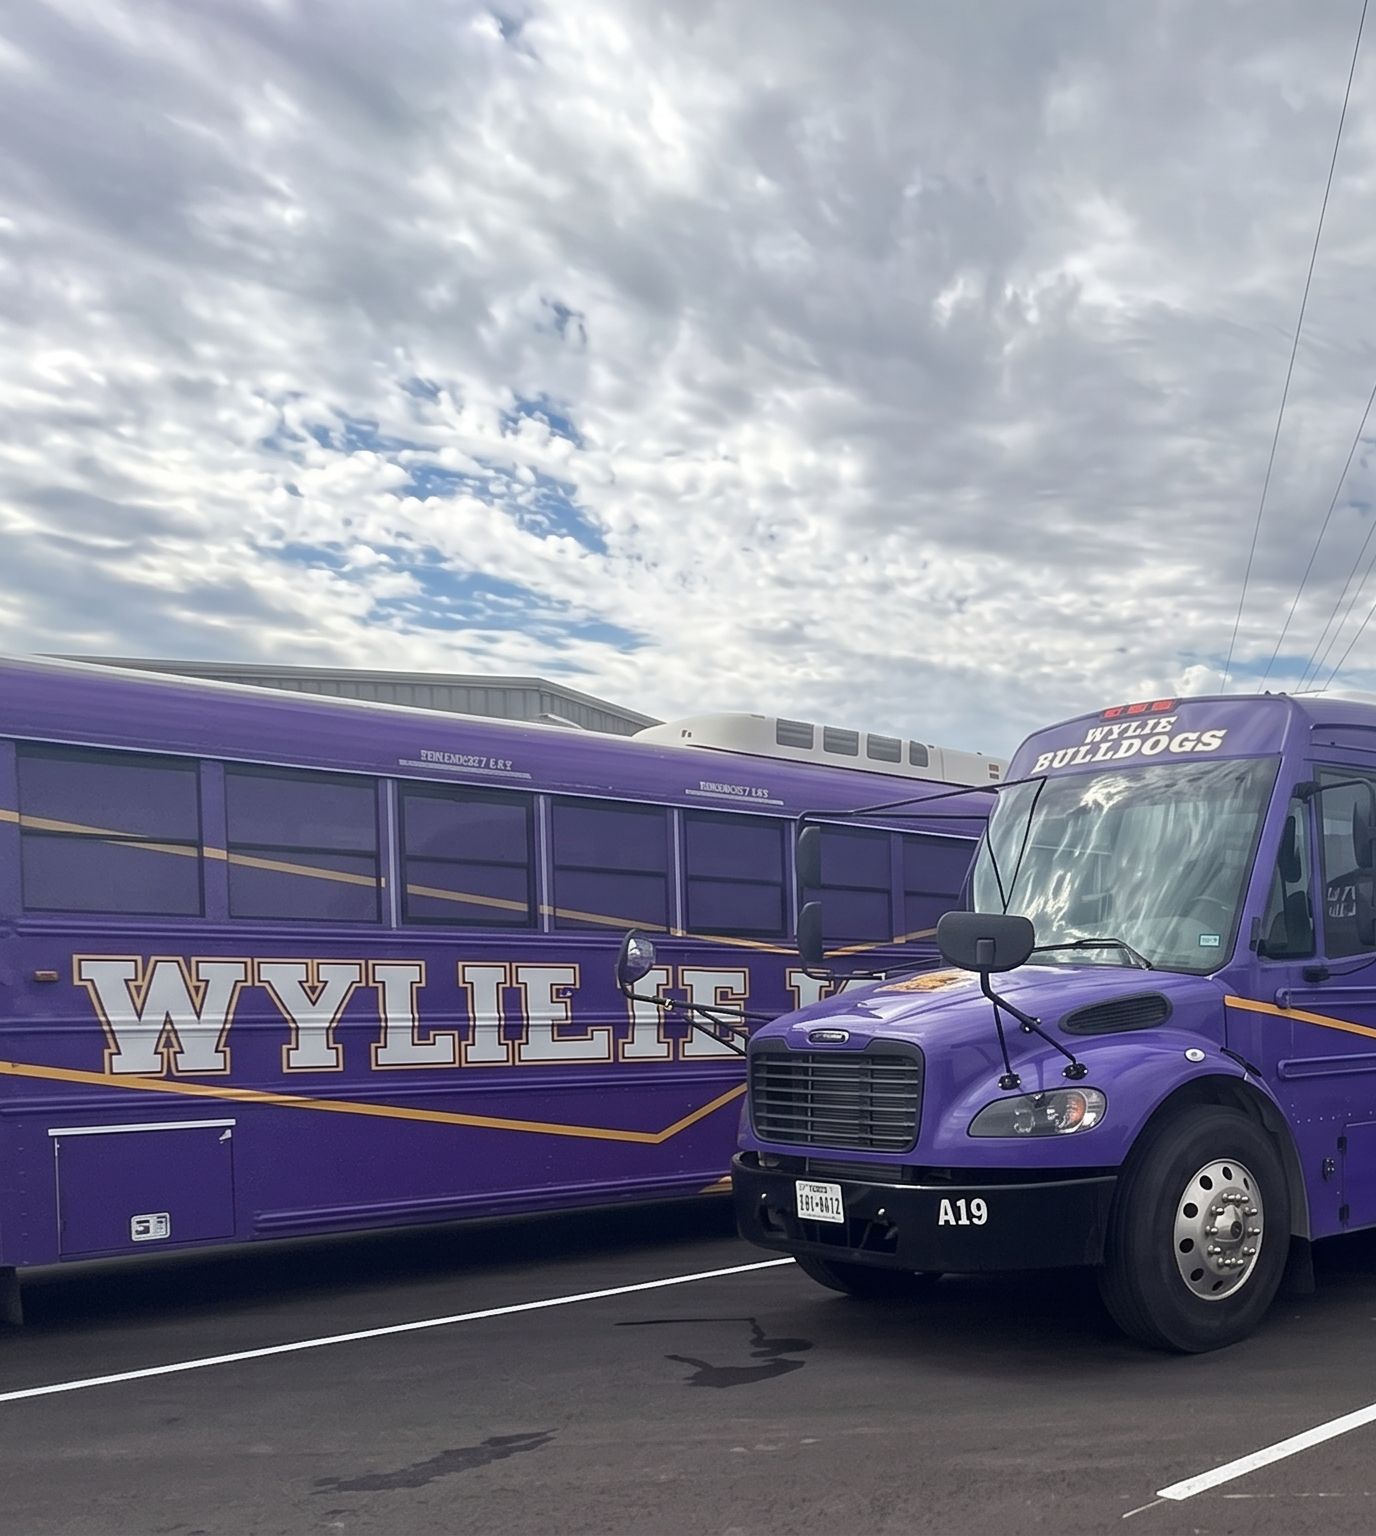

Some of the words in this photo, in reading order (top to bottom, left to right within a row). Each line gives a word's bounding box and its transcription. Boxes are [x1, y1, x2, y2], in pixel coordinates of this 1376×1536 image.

[1084, 715, 1178, 744] WYLIE
[1030, 729, 1228, 775] BULLDOGS
[938, 1198, 988, 1226] A19
